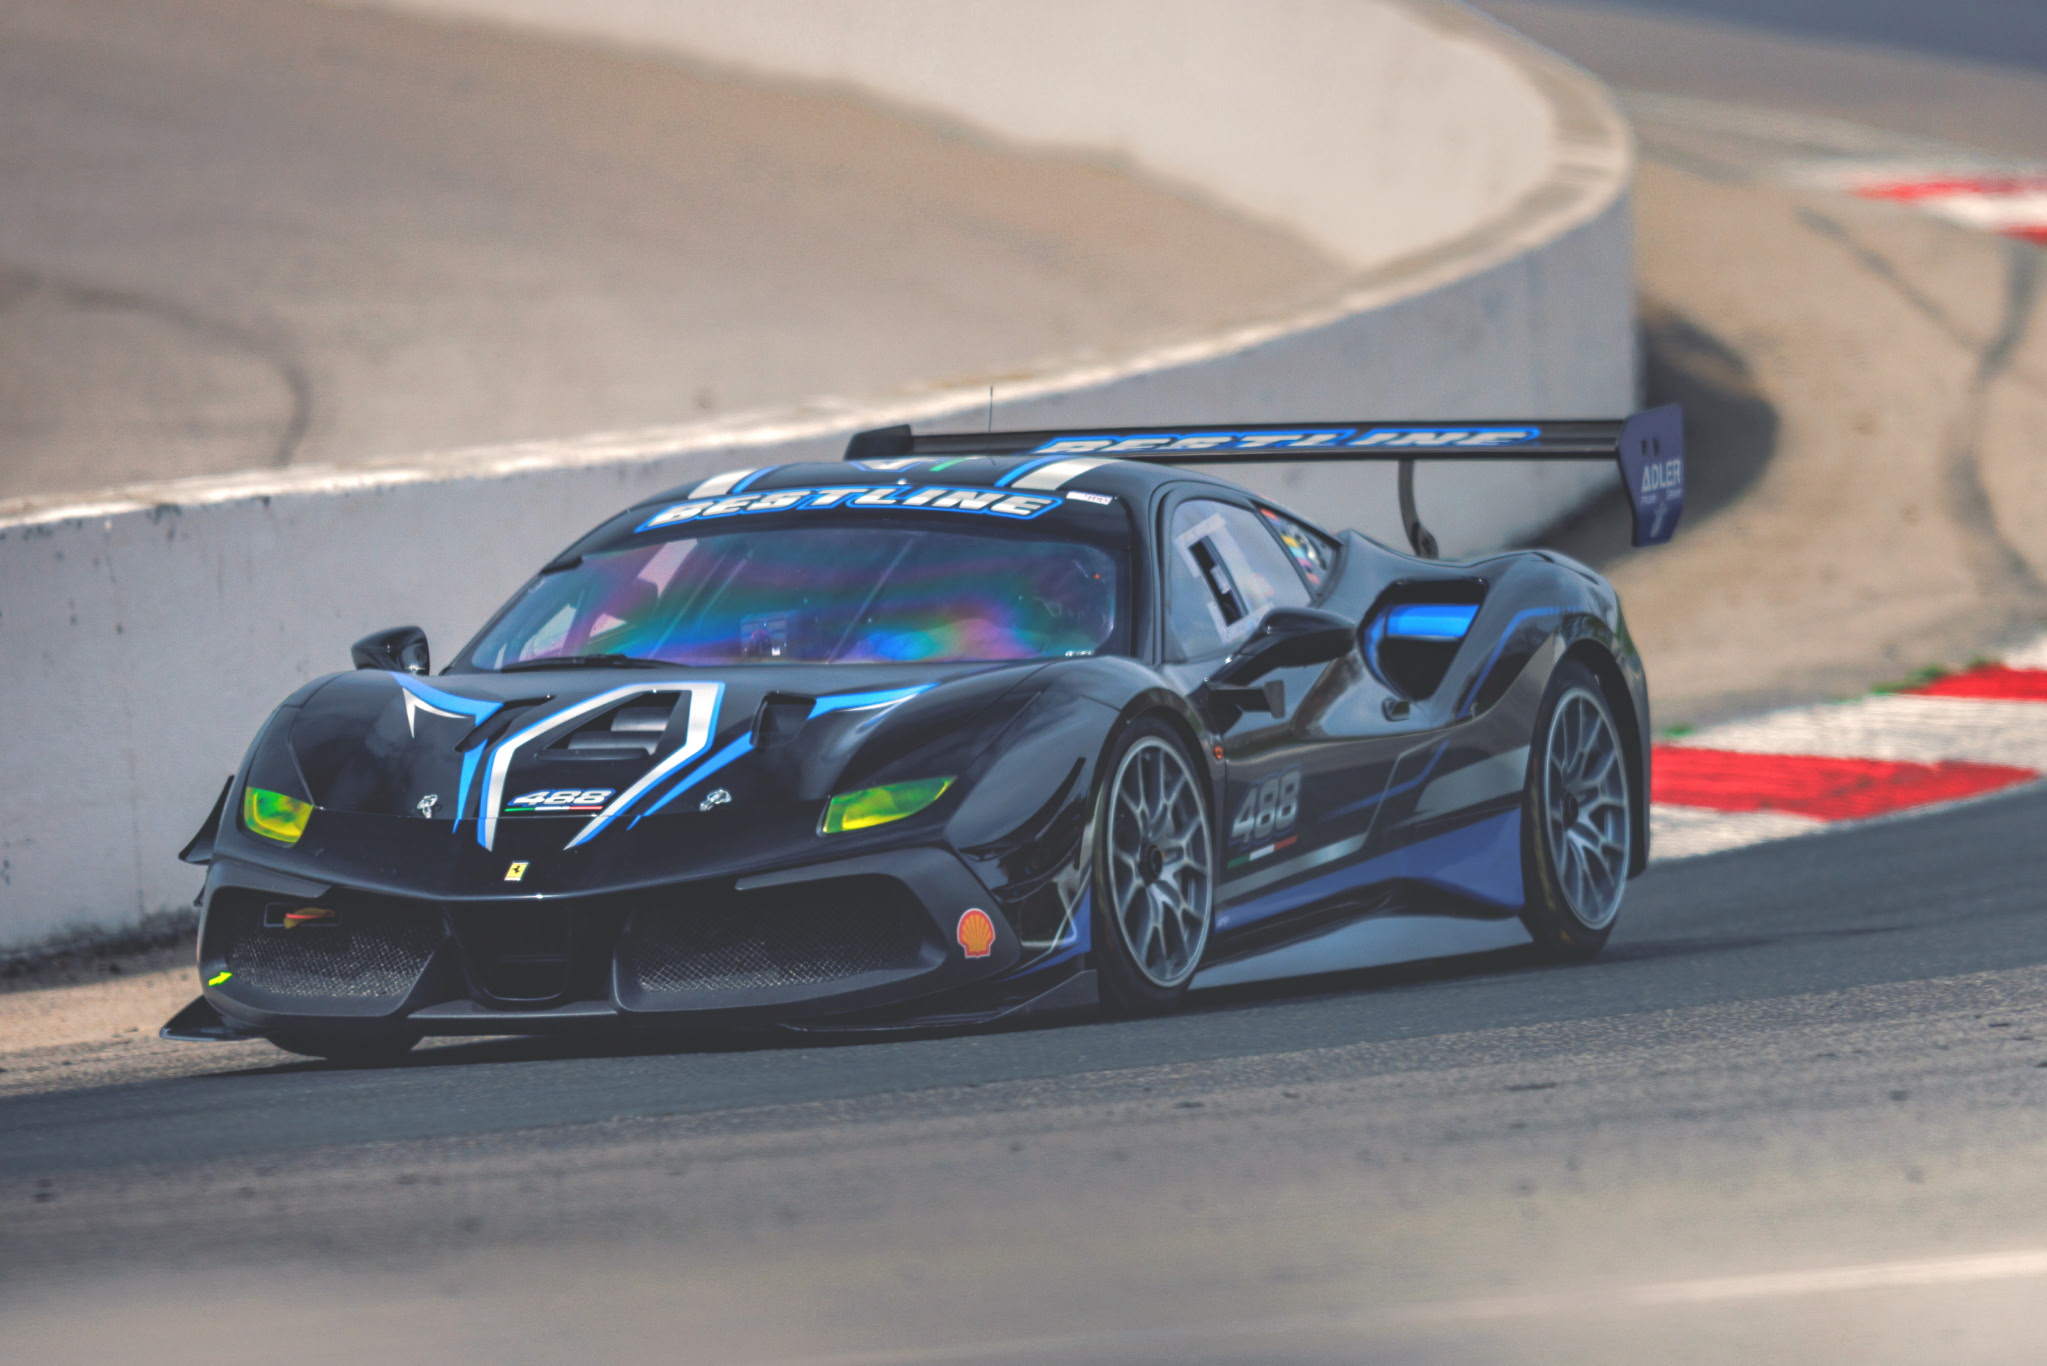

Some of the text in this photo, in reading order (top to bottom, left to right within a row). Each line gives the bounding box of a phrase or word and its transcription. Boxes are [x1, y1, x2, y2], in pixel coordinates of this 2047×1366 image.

[1641, 459, 1681, 493] ADLER
[642, 486, 1056, 528] BESTLINE
[510, 789, 614, 807] 488
[1231, 768, 1301, 844] 488
